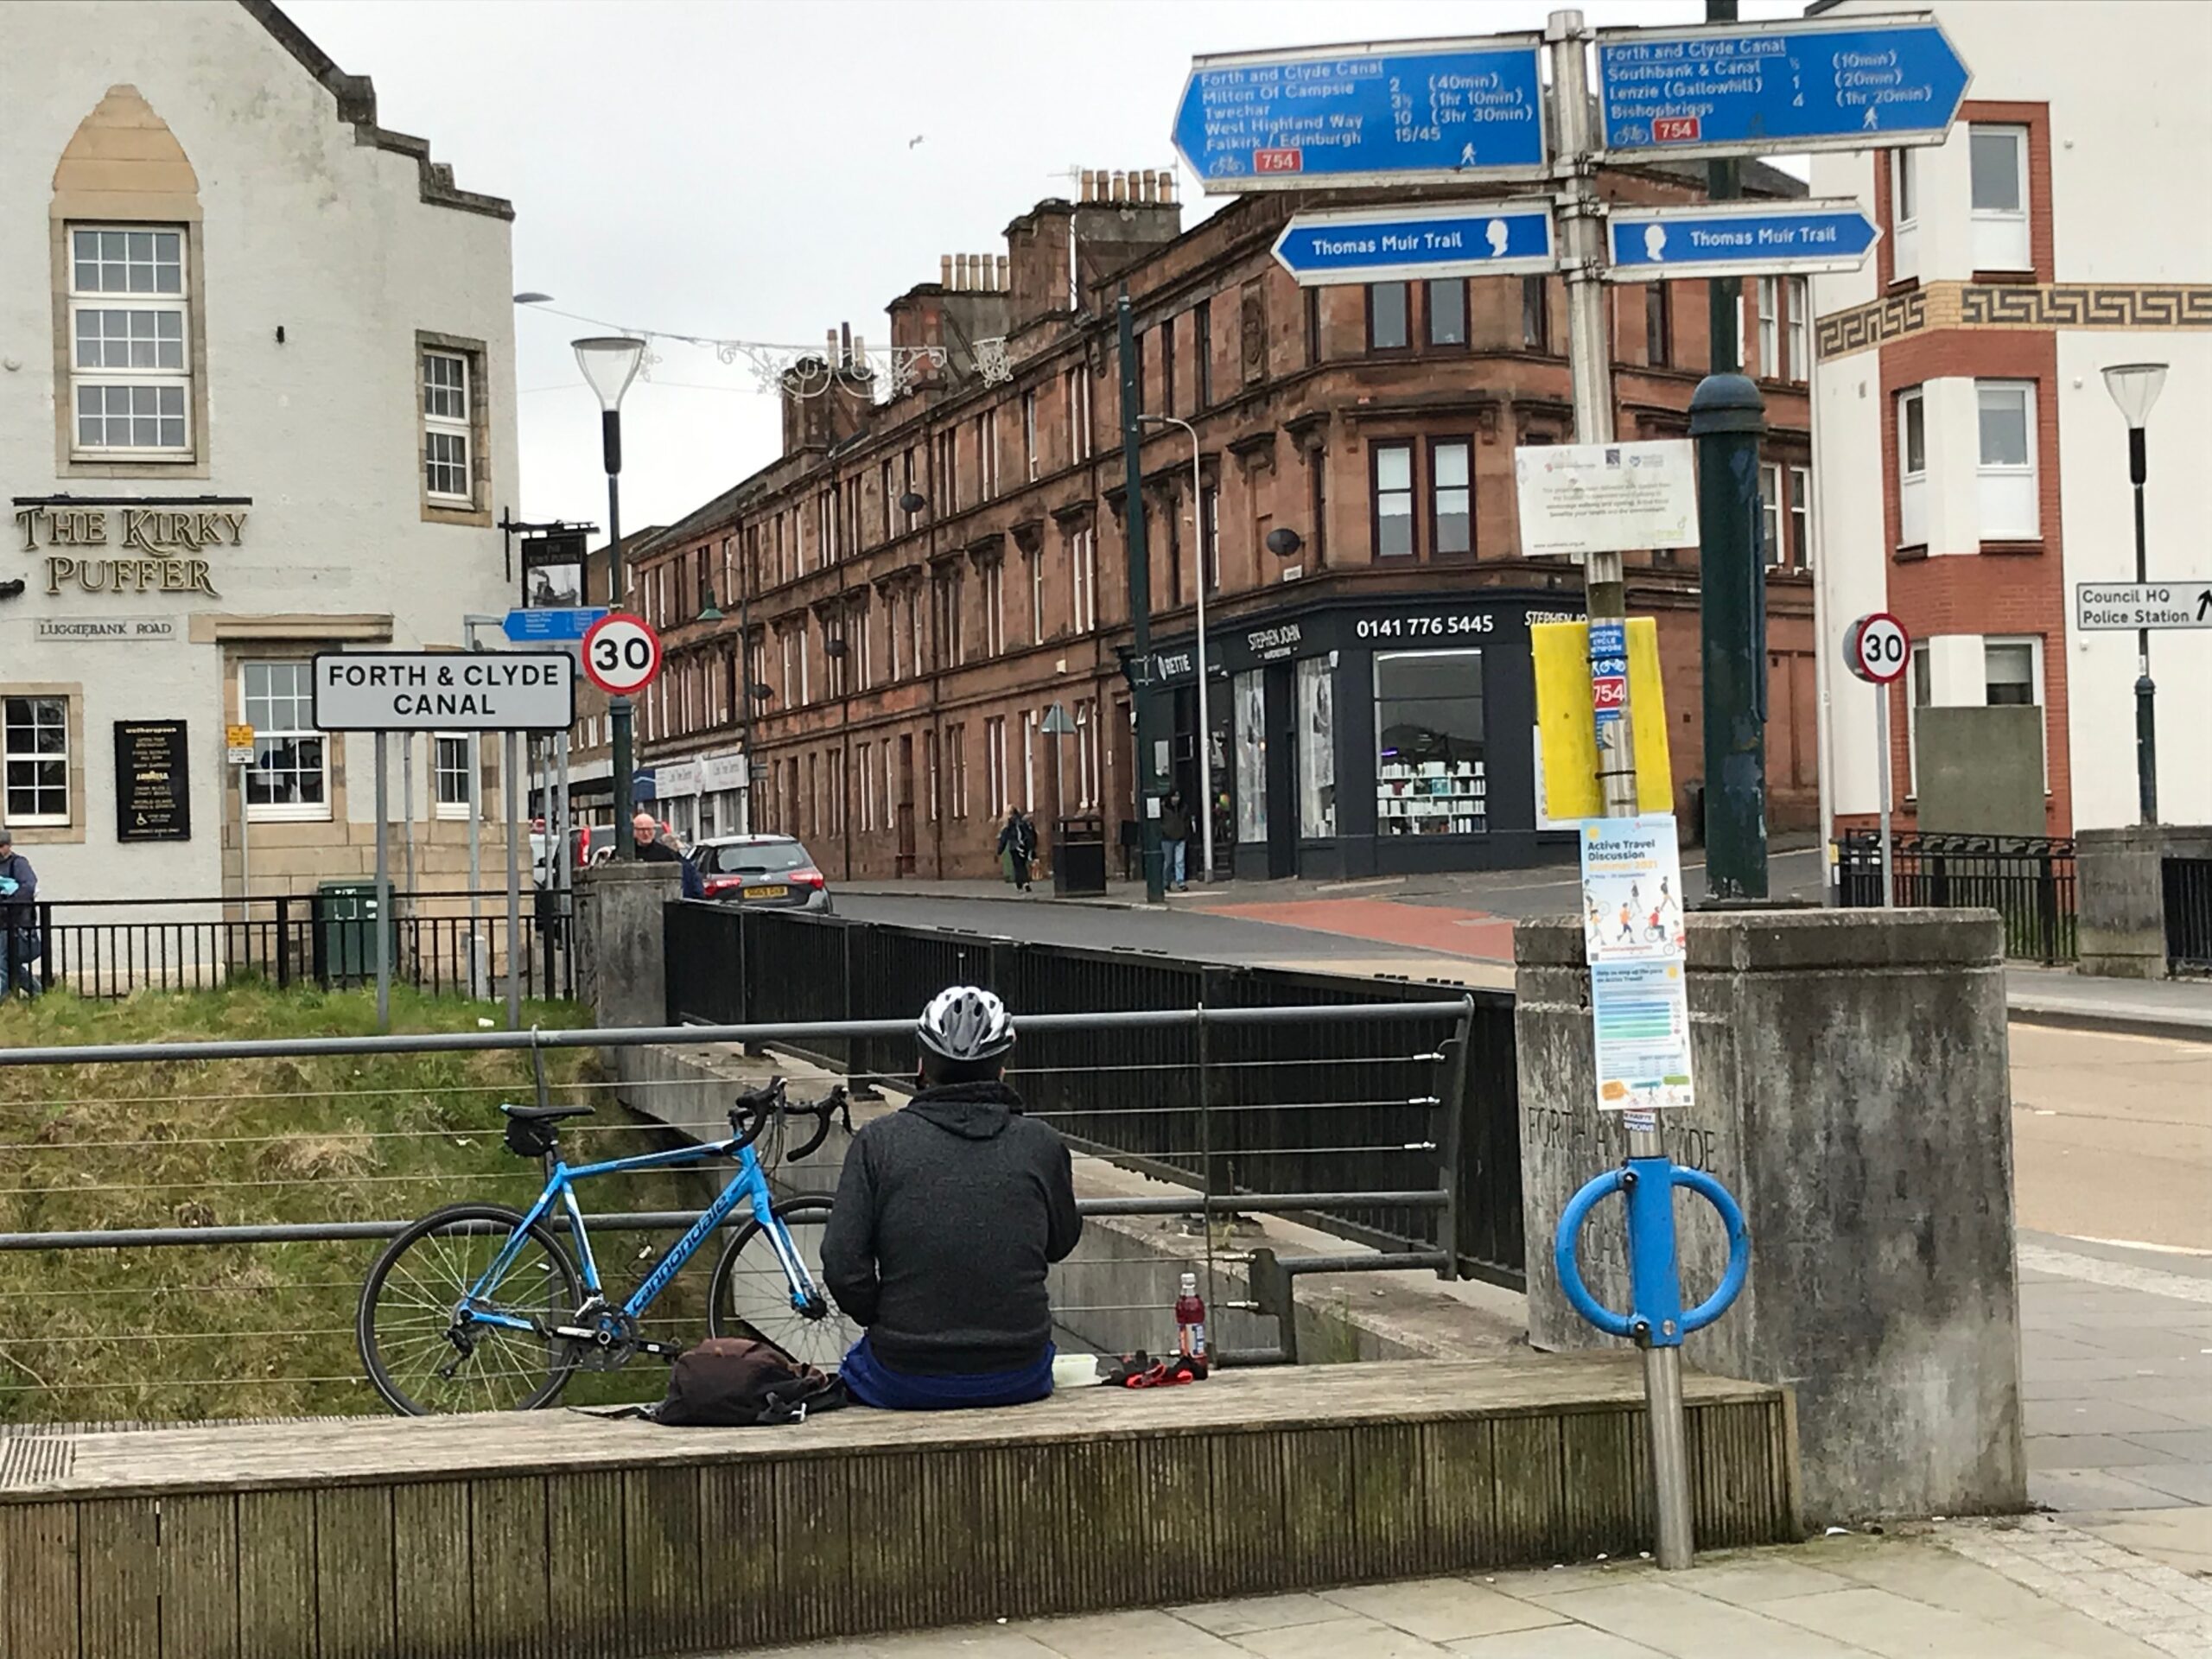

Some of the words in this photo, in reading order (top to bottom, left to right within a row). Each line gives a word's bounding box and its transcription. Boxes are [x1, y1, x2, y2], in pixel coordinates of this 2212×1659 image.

[1607, 48, 1649, 61] Forth
[1655, 44, 1683, 58] and
[1688, 41, 1733, 58] Clyde
[1740, 38, 1785, 54] Canal
[1202, 72, 1244, 87] Forth
[1250, 67, 1279, 82] and
[1285, 64, 1331, 80] Clyde
[1337, 60, 1382, 75] Canal
[1608, 64, 1693, 82] Southbank
[1699, 63, 1709, 76] &
[1715, 60, 1761, 75] Canal
[1834, 69, 1903, 88] (20min)
[1389, 77, 1400, 92] 2
[1429, 72, 1498, 92] (40min)
[1610, 85, 1658, 100] Lenzie
[1664, 77, 1763, 99] (Gallowhill)
[1793, 75, 1800, 89] 1
[1203, 88, 1255, 105] Milton
[1261, 86, 1279, 99] Of
[1286, 83, 1355, 99] Campsie
[1430, 92, 1460, 108] (1hr
[1468, 86, 1522, 105] 10min)
[1792, 92, 1804, 106] 4
[1205, 105, 1270, 120] Twechar
[1395, 111, 1412, 125] 10
[1432, 107, 1466, 125] (3hr
[1473, 104, 1533, 123] 30min)
[1611, 102, 1713, 119] Bishopbriggs
[1205, 120, 1243, 136] West
[1252, 115, 1323, 134] Highland
[1330, 114, 1363, 130] Way
[1395, 126, 1440, 143] 15/45
[1661, 122, 1692, 138] 754
[1206, 137, 1261, 151] Falkirk
[1280, 131, 1362, 148] Edinburgh
[1262, 153, 1294, 169] 754
[1312, 238, 1376, 256] Thomas
[1382, 235, 1419, 251] Muir
[1424, 232, 1462, 249] Trail
[1690, 230, 1753, 247] Thomas
[1758, 227, 1796, 244] Muir
[1799, 226, 1836, 242] Trail
[121, 509, 247, 556] KIRKY
[44, 556, 222, 599] PUFFER
[2082, 590, 2140, 603] Council
[2146, 588, 2170, 603] HQ
[1357, 619, 1402, 638] 0141
[1407, 618, 1443, 635] 776
[1447, 615, 1493, 633] 5445
[2083, 610, 2128, 623] Police
[2134, 609, 2190, 623] Station
[40, 623, 127, 637] LUGGIEBANK
[137, 623, 172, 635] ROAD
[1248, 630, 1281, 651] STEPHEN
[1281, 624, 1301, 645] JOHN
[594, 638, 650, 671] 30
[1866, 634, 1903, 662] 30
[329, 665, 426, 686] FORTH
[437, 665, 454, 686] &
[464, 664, 558, 686] CLYDE
[1593, 683, 1624, 702] 754
[393, 694, 496, 715] CANAL
[1587, 841, 1620, 850] Active
[1623, 839, 1656, 849] Travel
[1588, 850, 1645, 861] Discussion
[632, 1196, 728, 1313] cannondale
